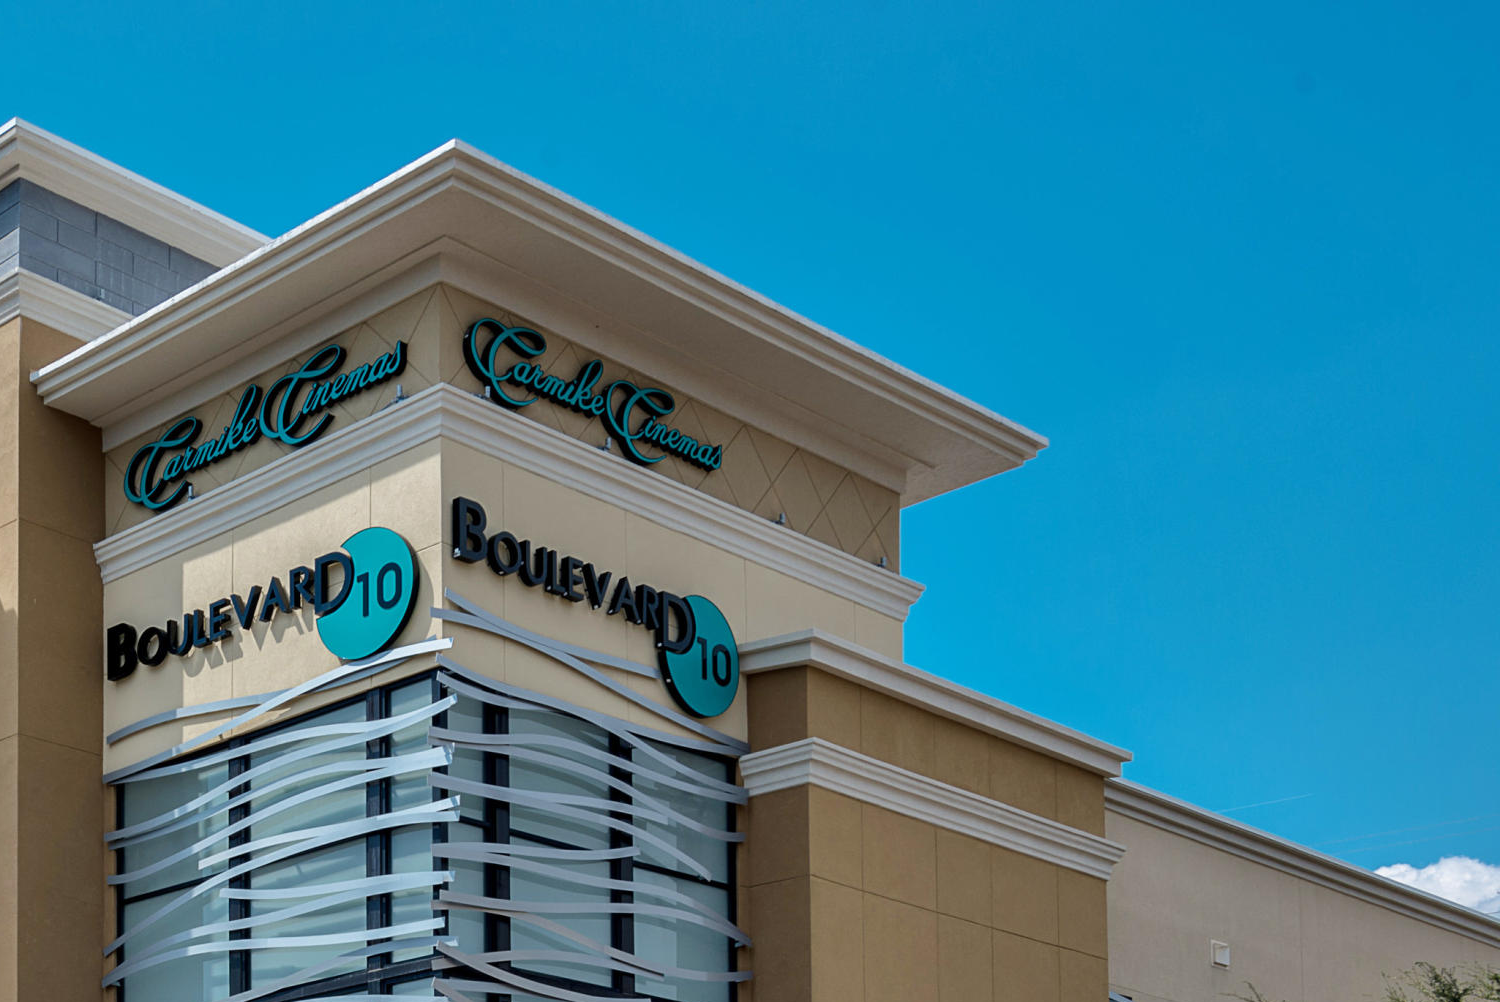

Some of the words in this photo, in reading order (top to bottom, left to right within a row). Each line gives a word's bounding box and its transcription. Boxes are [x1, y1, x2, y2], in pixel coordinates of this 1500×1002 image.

[123, 416, 263, 511] Carmike
[259, 343, 407, 447] Cinemas
[463, 317, 606, 417] Carmike
[600, 379, 724, 472] Cinemas
[107, 551, 355, 681] BOULEVARD
[357, 562, 402, 618] 10
[452, 496, 696, 655] BOULEVARD
[697, 637, 732, 687] 10
